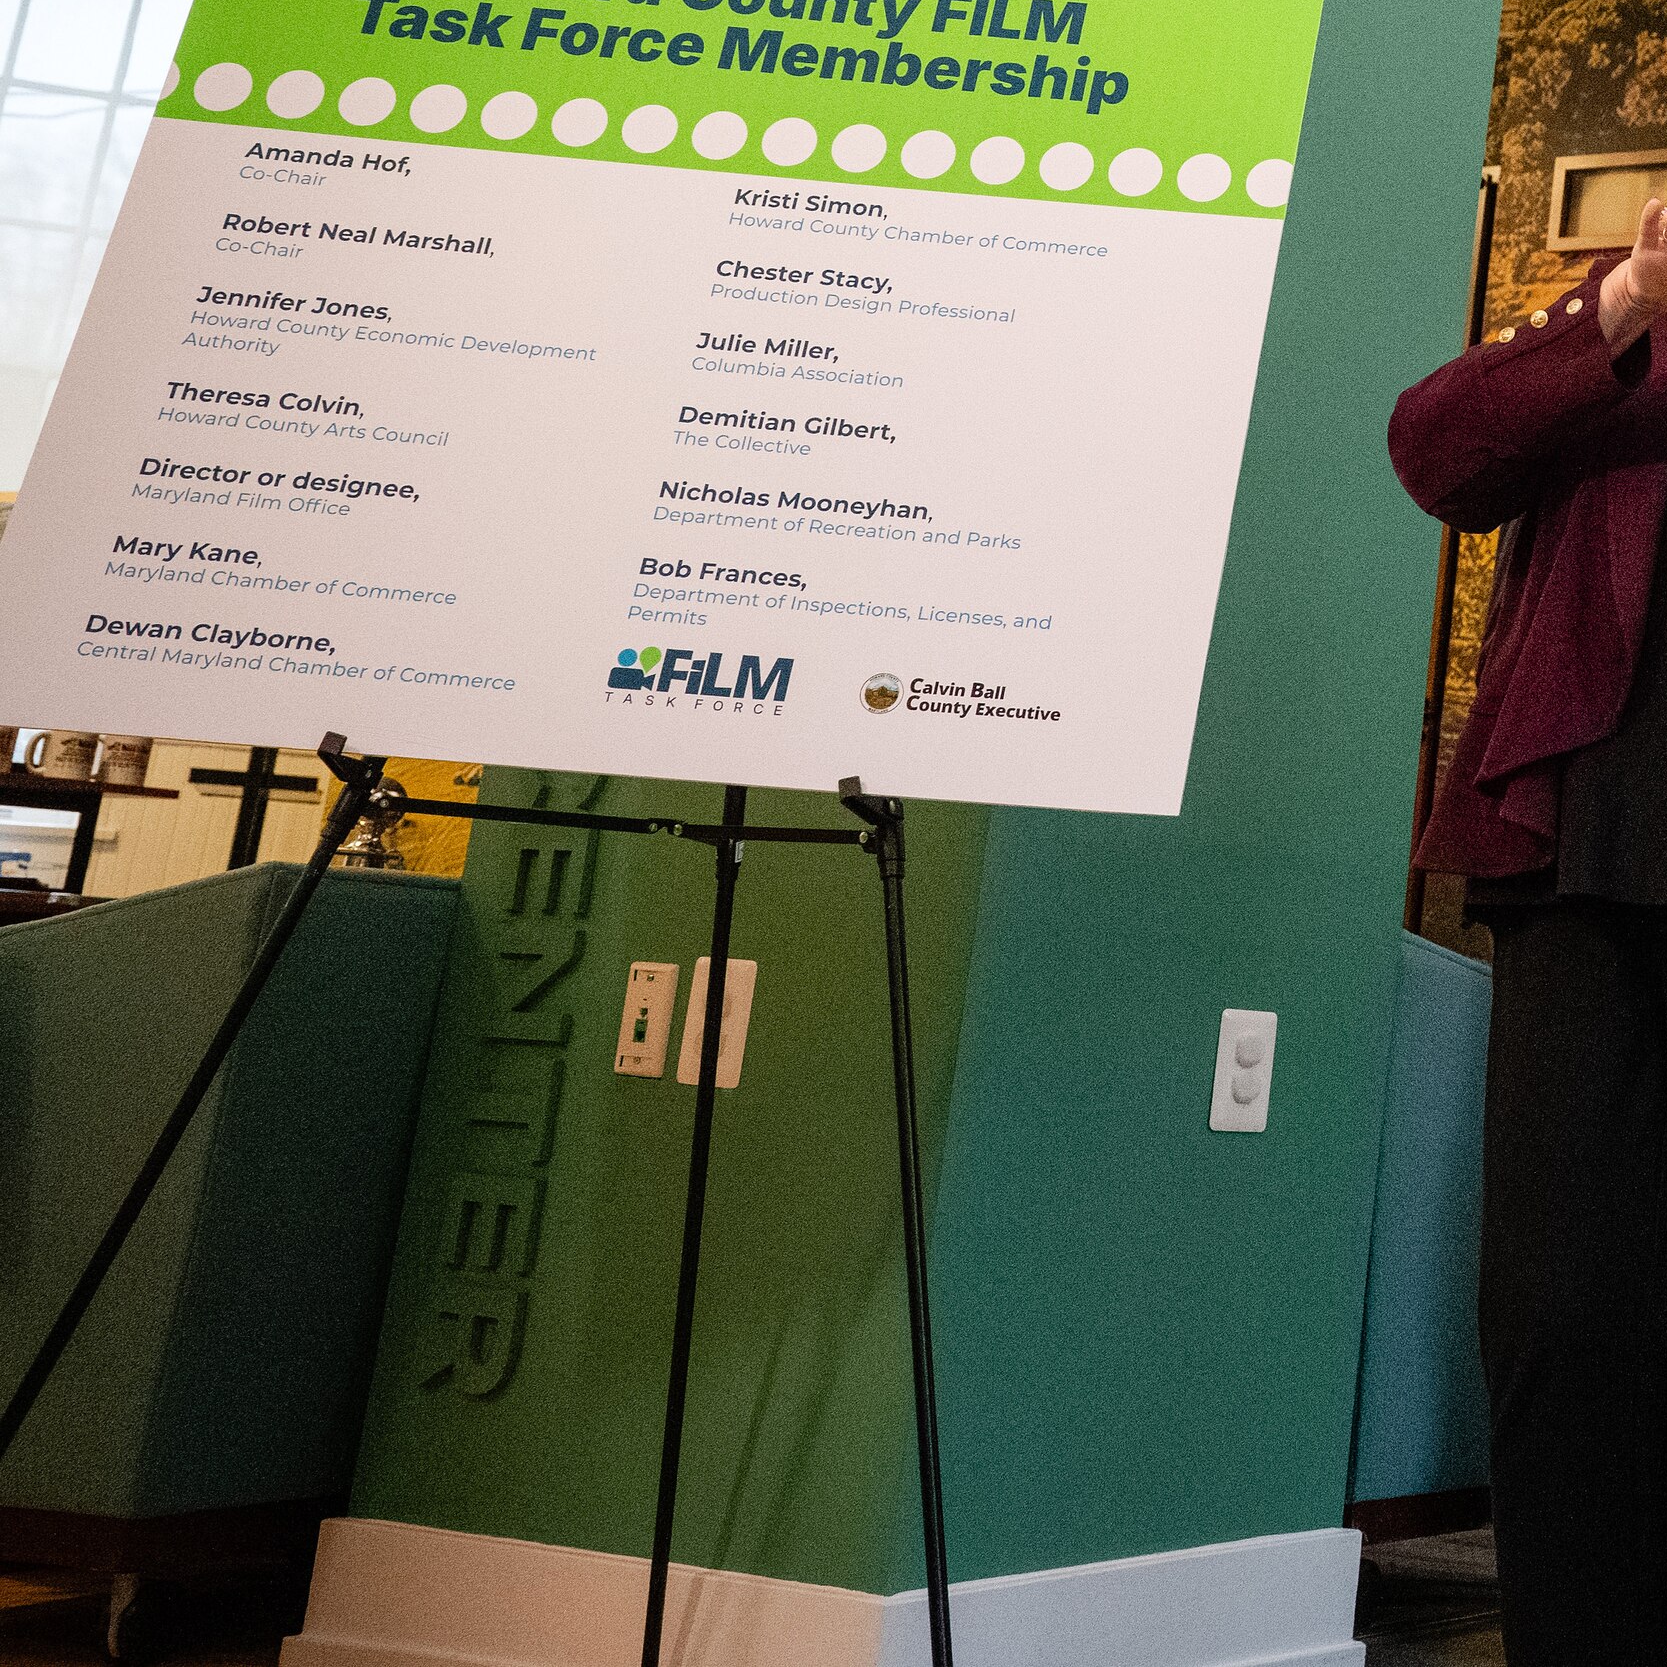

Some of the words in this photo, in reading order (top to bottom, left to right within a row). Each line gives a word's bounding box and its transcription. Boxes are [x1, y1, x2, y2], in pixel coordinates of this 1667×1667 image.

[519, 6, 706, 68] Force
[716, 25, 1130, 116] Membership
[237, 164, 328, 187] Co-Chair
[243, 141, 355, 169] Amanda
[360, 152, 412, 178] Hof,
[733, 187, 801, 211] Kristi
[803, 193, 889, 222] Simon,
[213, 235, 305, 259] Co-Chair
[221, 212, 313, 239] Robert
[317, 222, 378, 245] Neal
[381, 228, 495, 259] Marshall,
[727, 210, 806, 233] Howard
[808, 218, 881, 242] County
[882, 224, 976, 247] Chamber
[977, 233, 1001, 250] of
[1001, 234, 1109, 259] Commerce
[715, 259, 815, 285] Chester
[818, 268, 894, 296] Stacy,
[194, 284, 308, 313] Jennifer
[309, 296, 393, 324] Jones,
[709, 282, 820, 307] Production
[823, 292, 893, 316] Design
[897, 298, 1017, 324] Professional
[179, 330, 282, 358] Authority
[188, 308, 274, 333] Howard
[274, 317, 352, 343] County
[353, 324, 456, 349] Economic
[459, 334, 597, 362] Development
[694, 331, 758, 355] Julie
[763, 336, 840, 365] Miller,
[690, 355, 787, 379] Columbia
[789, 364, 905, 389] Association
[166, 380, 272, 409] Theresa
[277, 391, 365, 420] Colvin,
[155, 405, 242, 429] Howard
[243, 413, 321, 439] County
[321, 421, 368, 440] Arts
[371, 425, 451, 447] Council
[672, 428, 711, 448] The
[713, 433, 813, 457] Collective
[677, 404, 797, 433] Demitian
[803, 415, 897, 445] Gilbert,
[129, 481, 233, 507] Maryland
[234, 491, 283, 512] Film
[286, 496, 352, 517] Office
[138, 456, 253, 485] Director
[256, 471, 288, 488] or
[291, 470, 421, 504] designee,
[658, 479, 771, 508] Nicholas
[776, 490, 934, 524] Mooneyhan,
[652, 504, 779, 532] Department
[782, 516, 807, 533] of
[807, 517, 918, 542] Recreation
[921, 529, 963, 546] and
[965, 530, 1022, 551] Parks
[111, 533, 185, 564] Mary
[187, 540, 263, 570] Kane,
[102, 559, 208, 585] Maryland
[209, 569, 312, 594] Chamber
[314, 578, 340, 596] of
[340, 580, 458, 606] Commerce
[638, 556, 693, 580] Bob
[698, 561, 808, 593] Frances,
[626, 604, 709, 627] Permits
[632, 581, 761, 608] Department
[763, 592, 789, 610] of
[789, 594, 912, 623] Inspections,
[916, 604, 1008, 630] Licenses,
[1012, 614, 1054, 631] and
[84, 613, 184, 641] Dewan
[189, 622, 337, 657] Clayborne,
[75, 639, 159, 663] Central
[159, 646, 265, 672] Maryland
[267, 655, 369, 680] Chamber
[372, 664, 398, 682] of
[398, 666, 517, 692] Commerce
[605, 690, 677, 708] TASK
[693, 698, 783, 717] FORCE
[908, 676, 967, 698] Calvin
[969, 681, 1007, 701] Ball
[905, 693, 973, 720] County
[974, 701, 1062, 723] Executive
